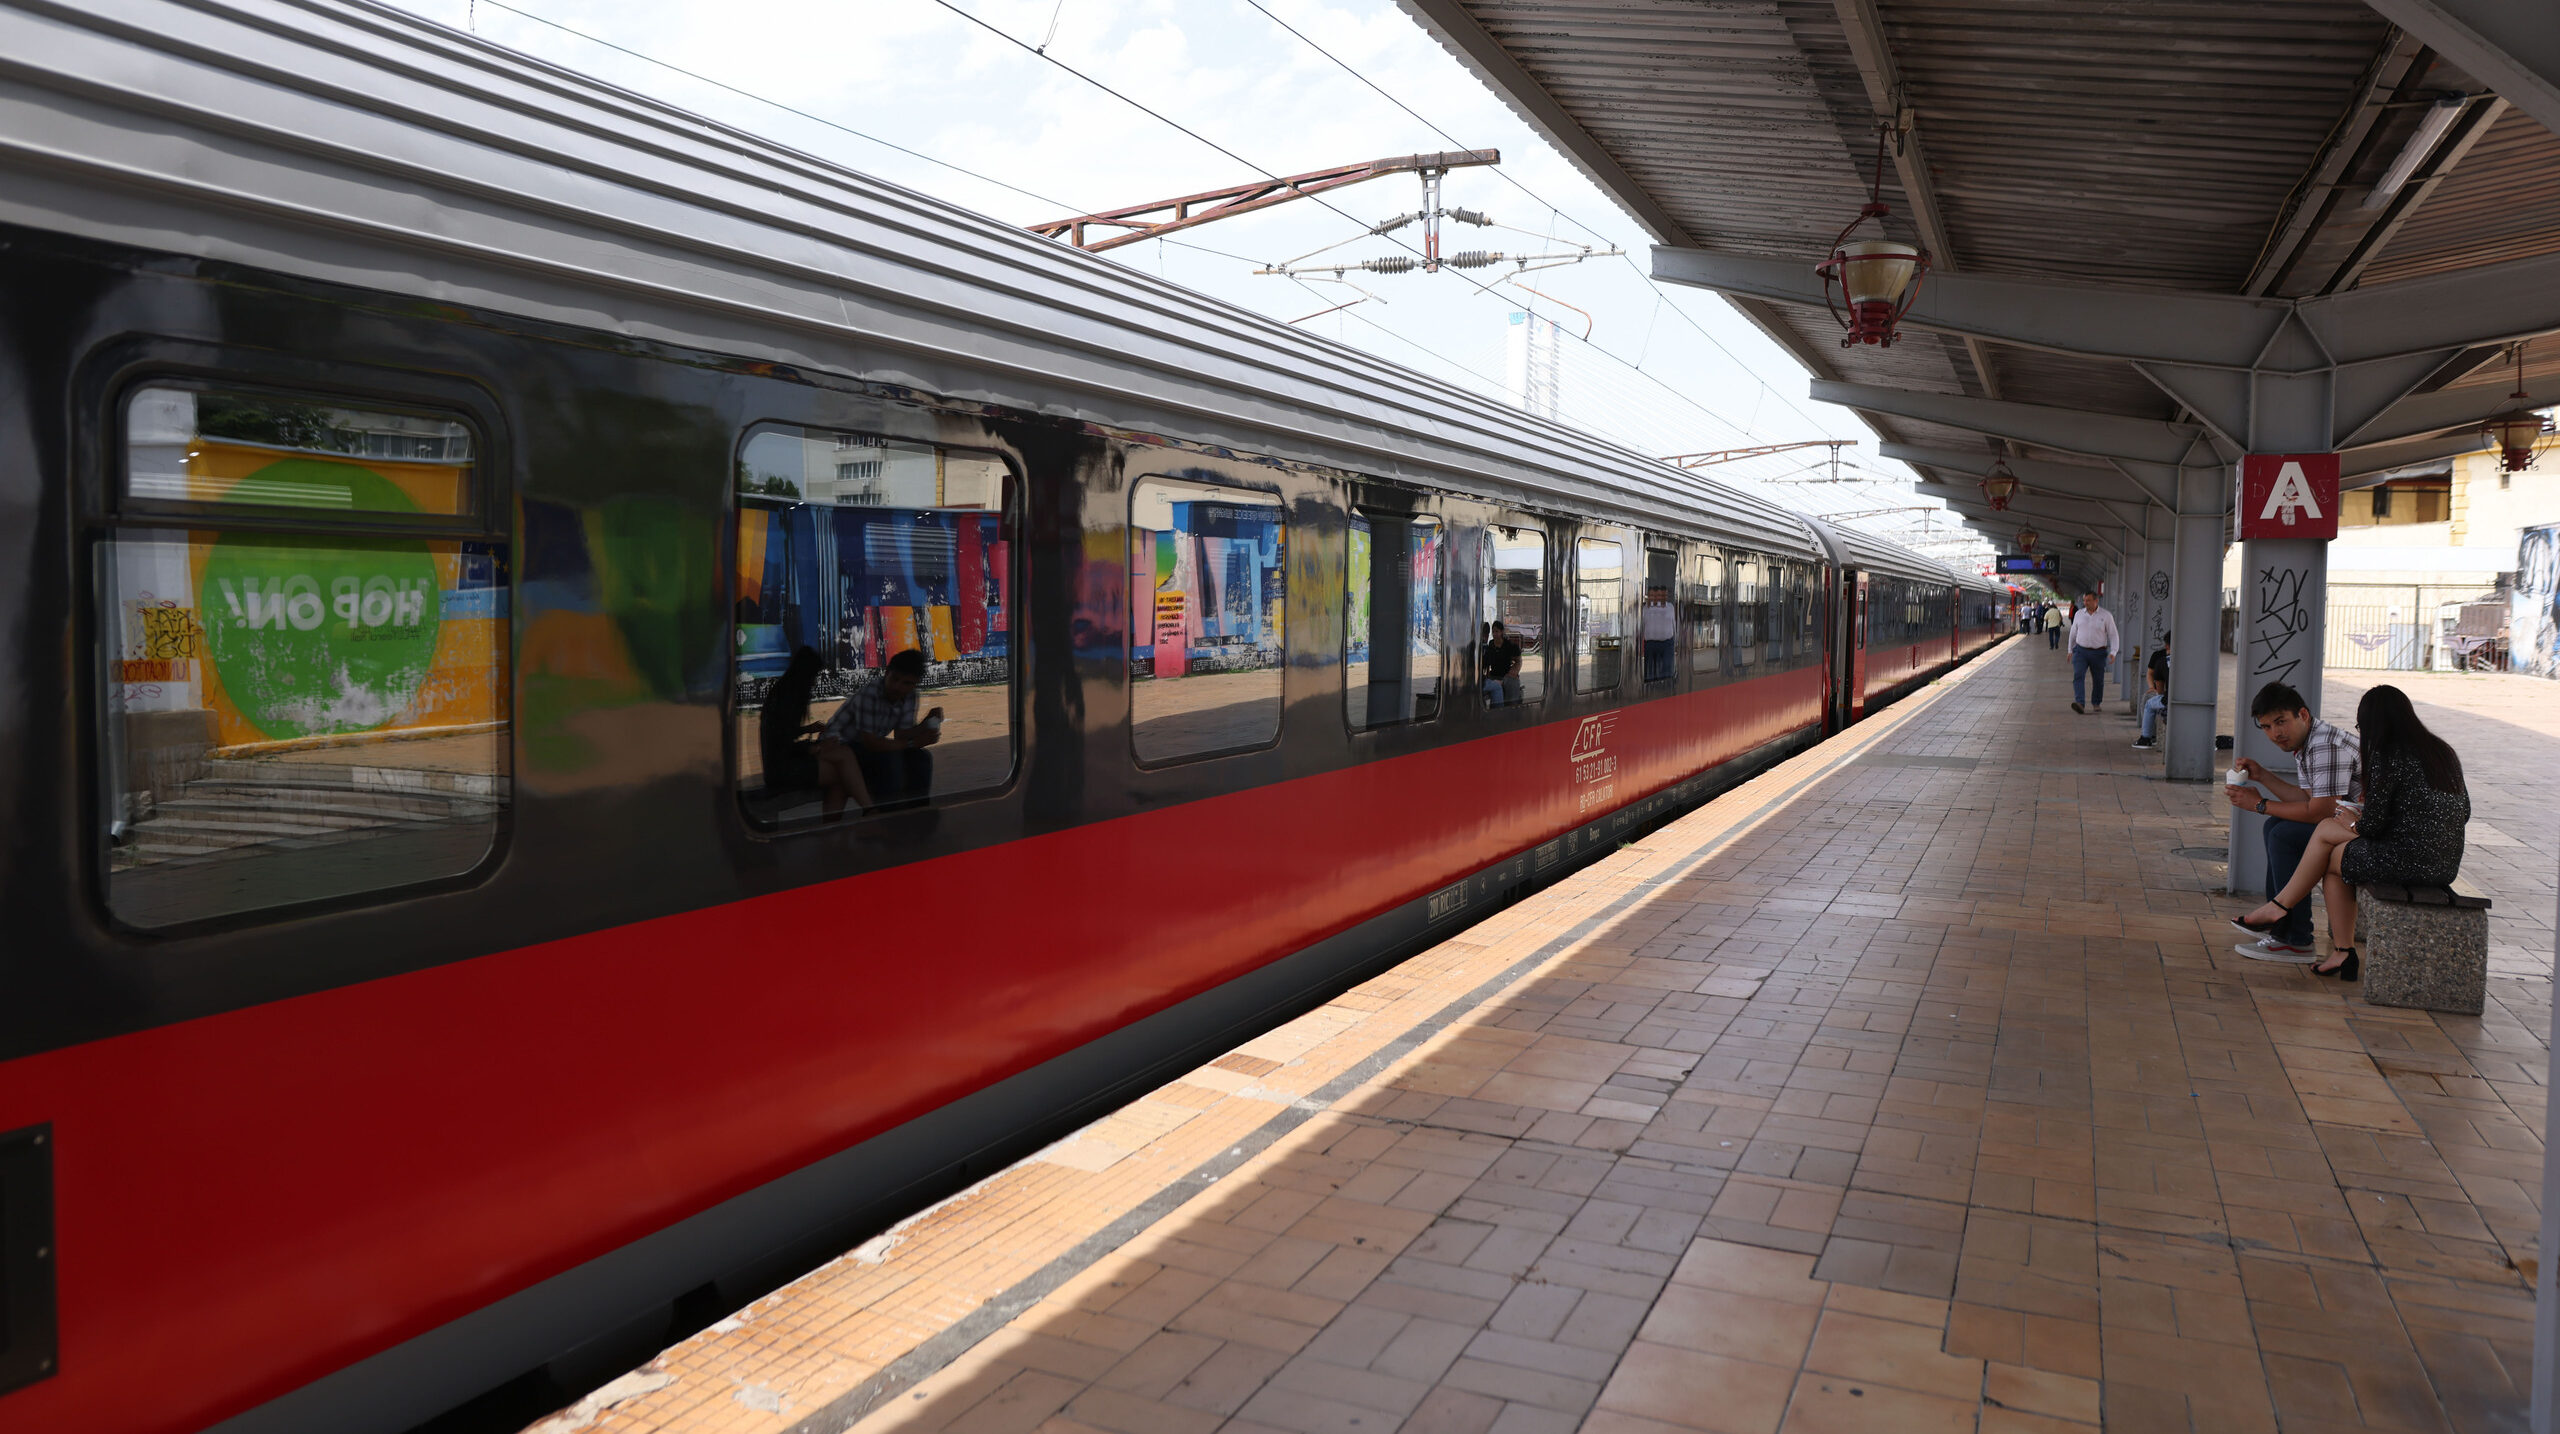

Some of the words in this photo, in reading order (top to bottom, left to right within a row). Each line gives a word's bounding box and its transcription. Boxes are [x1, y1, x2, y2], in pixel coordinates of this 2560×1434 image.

[2260, 462, 2323, 519] A
[1583, 722, 1602, 751] CFR
[1575, 767, 1582, 784] 61
